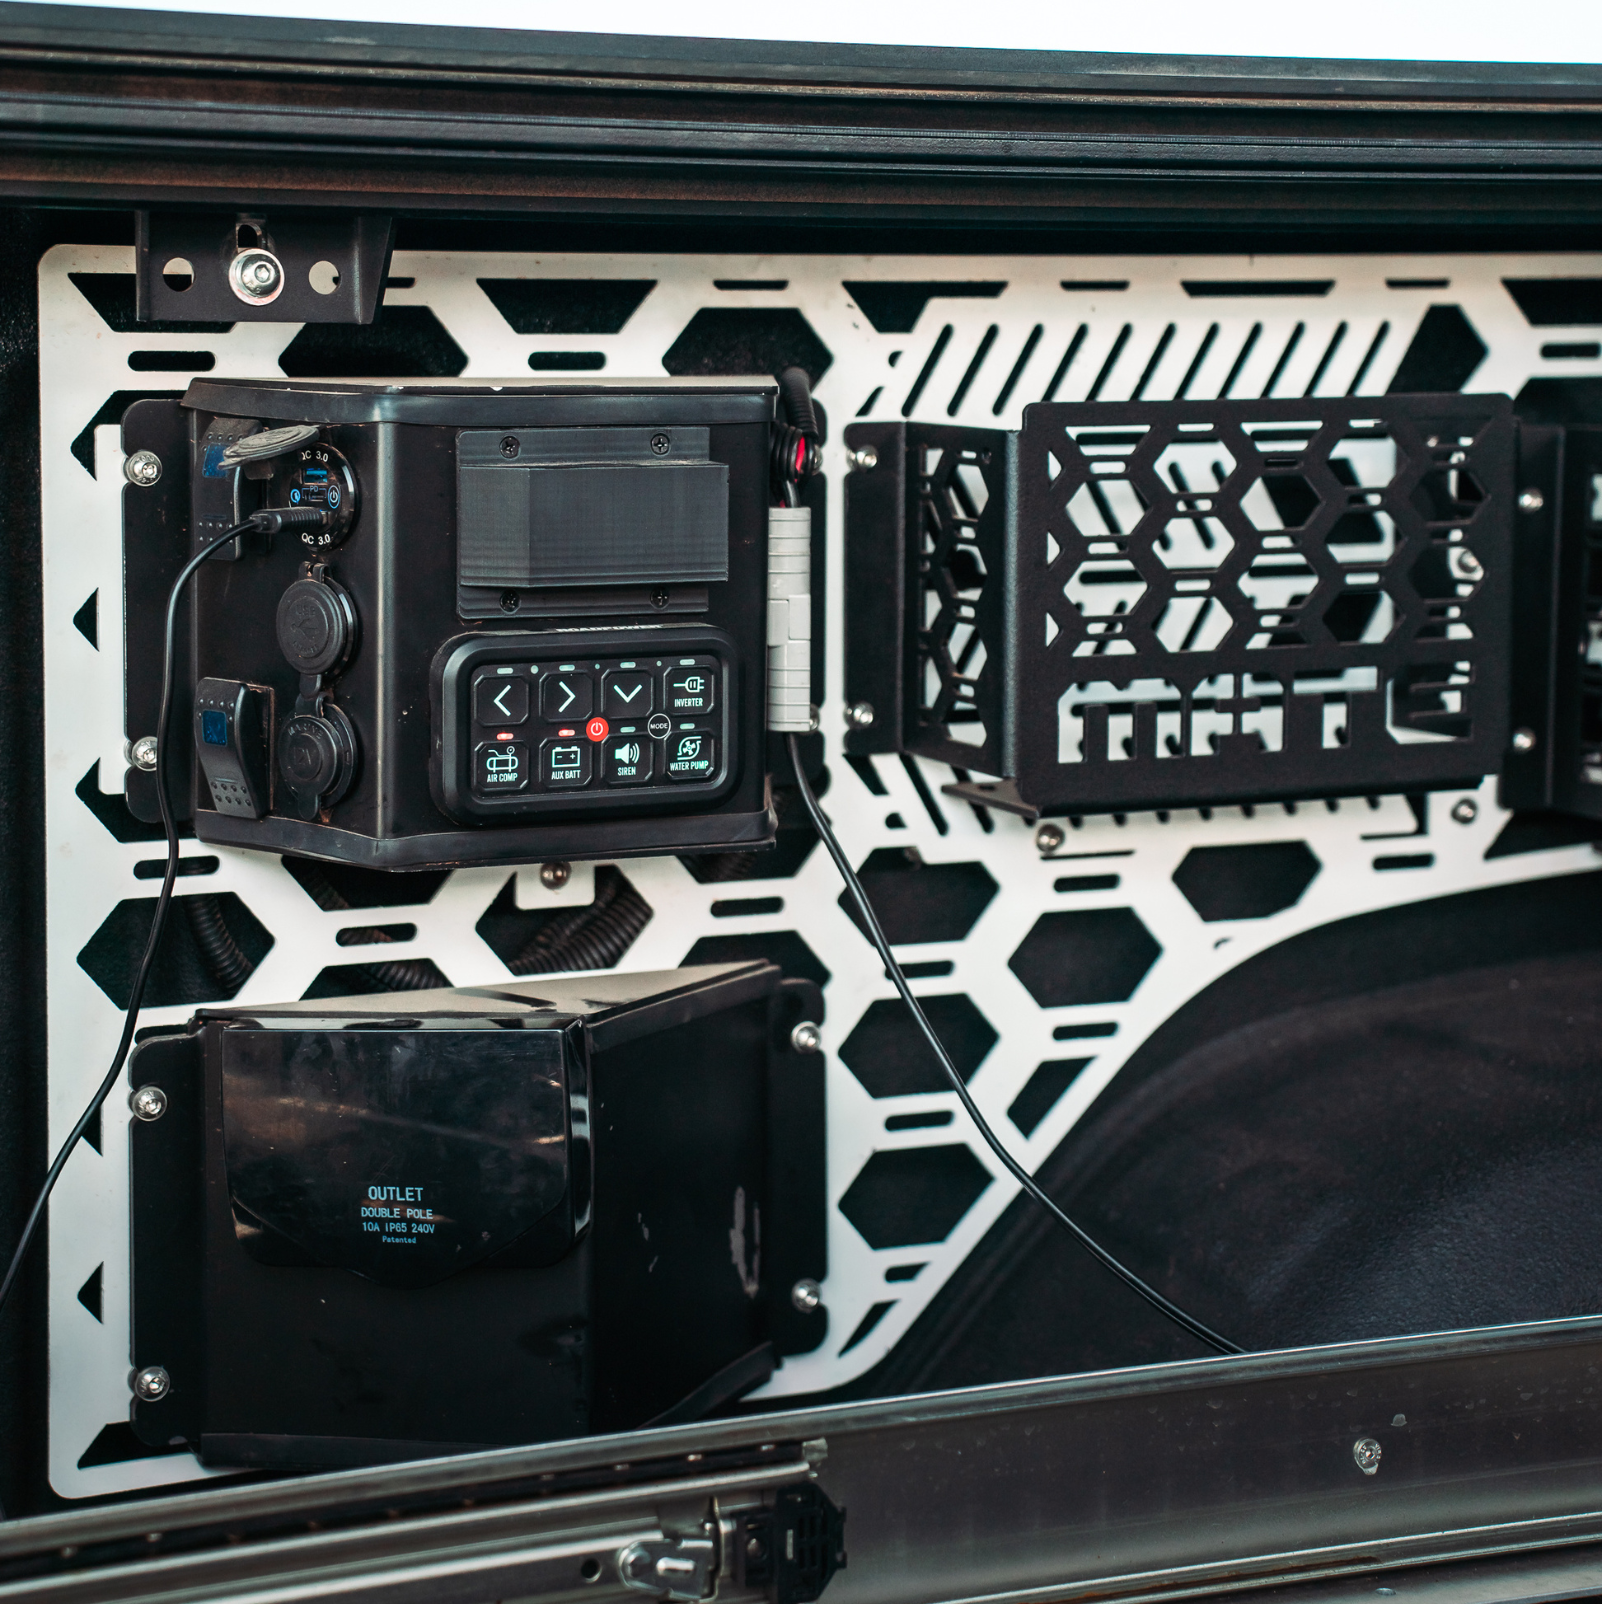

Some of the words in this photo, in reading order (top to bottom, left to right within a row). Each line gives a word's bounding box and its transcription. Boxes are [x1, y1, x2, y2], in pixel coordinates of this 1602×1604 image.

[315, 450, 329, 462] 3.0
[301, 532, 315, 545] QC
[318, 533, 331, 545] 3.0
[674, 698, 704, 708] INVERTER
[650, 722, 668, 730] MODE
[617, 766, 637, 776] SIREN
[669, 762, 690, 772] WATER
[690, 760, 709, 772] PUMP
[487, 773, 498, 783] AIR
[499, 772, 519, 783] COMP
[551, 769, 564, 780] AUX
[565, 769, 582, 780] BATT
[368, 1186, 424, 1202] OUTLET
[360, 1206, 401, 1219] DOUBLE
[407, 1208, 434, 1220] POLE
[362, 1221, 380, 1232] 10A
[385, 1222, 408, 1233] IP65
[411, 1223, 435, 1234] 240V
[382, 1235, 417, 1244] Patented
